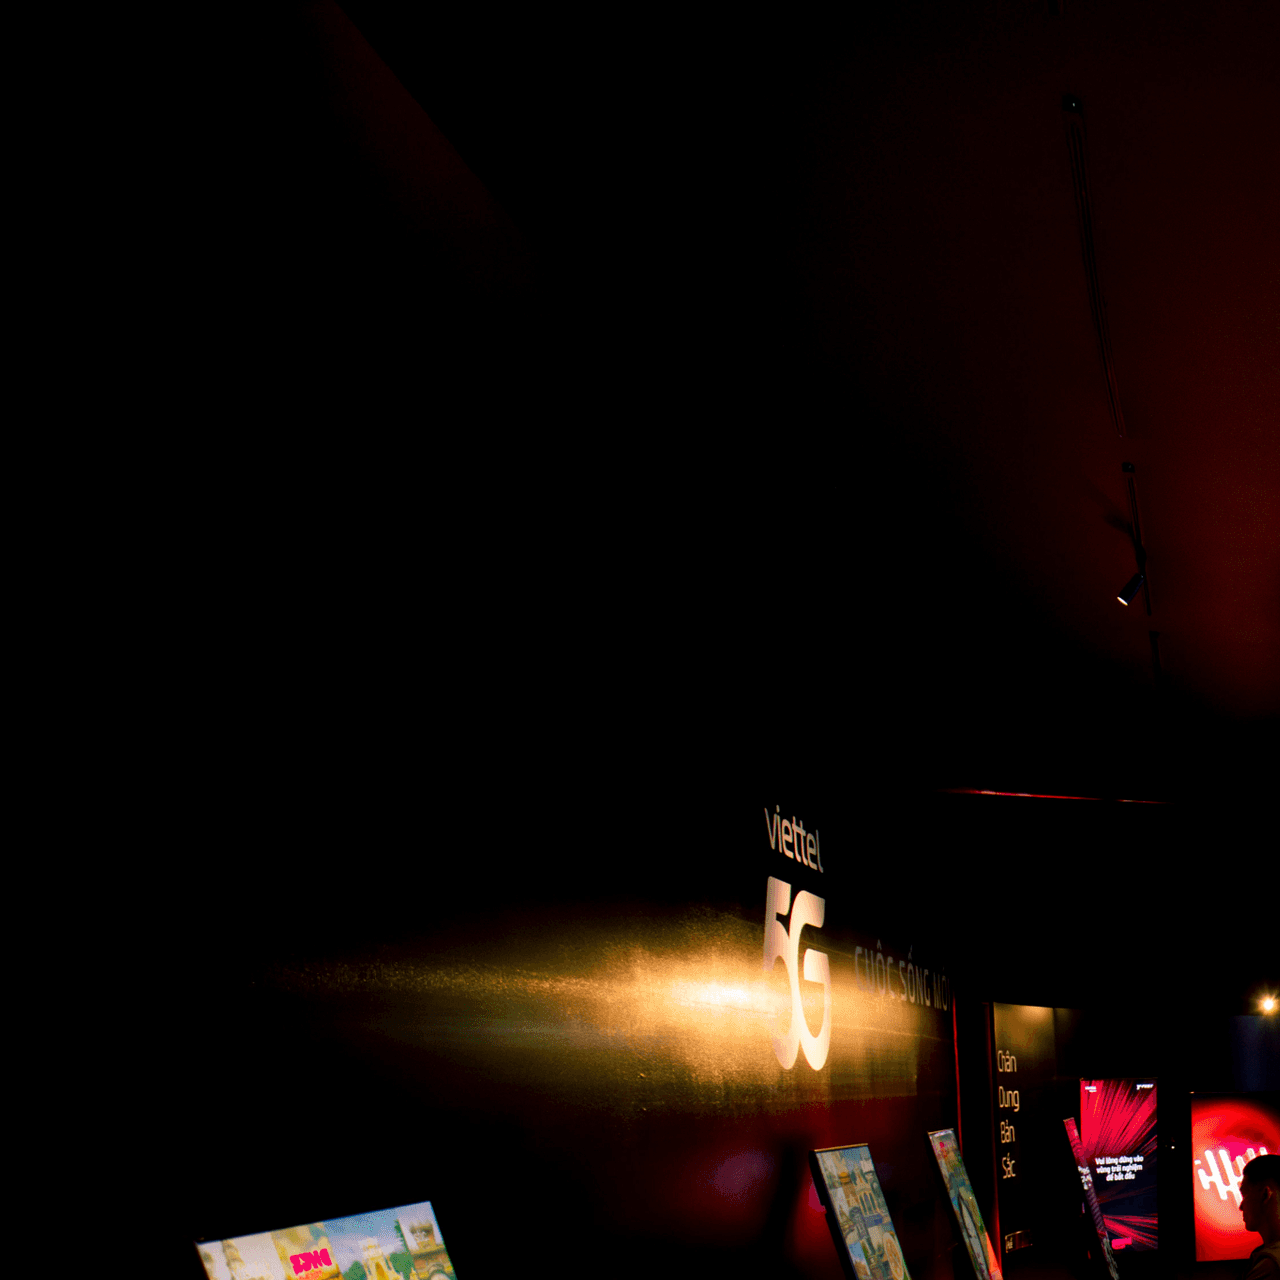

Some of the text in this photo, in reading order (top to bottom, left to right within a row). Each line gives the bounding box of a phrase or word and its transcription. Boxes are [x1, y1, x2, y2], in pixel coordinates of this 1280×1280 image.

[764, 804, 824, 874] viettel
[763, 875, 832, 1071] 5G
[997, 1049, 1018, 1073] Chân
[999, 1085, 1021, 1113] Dung
